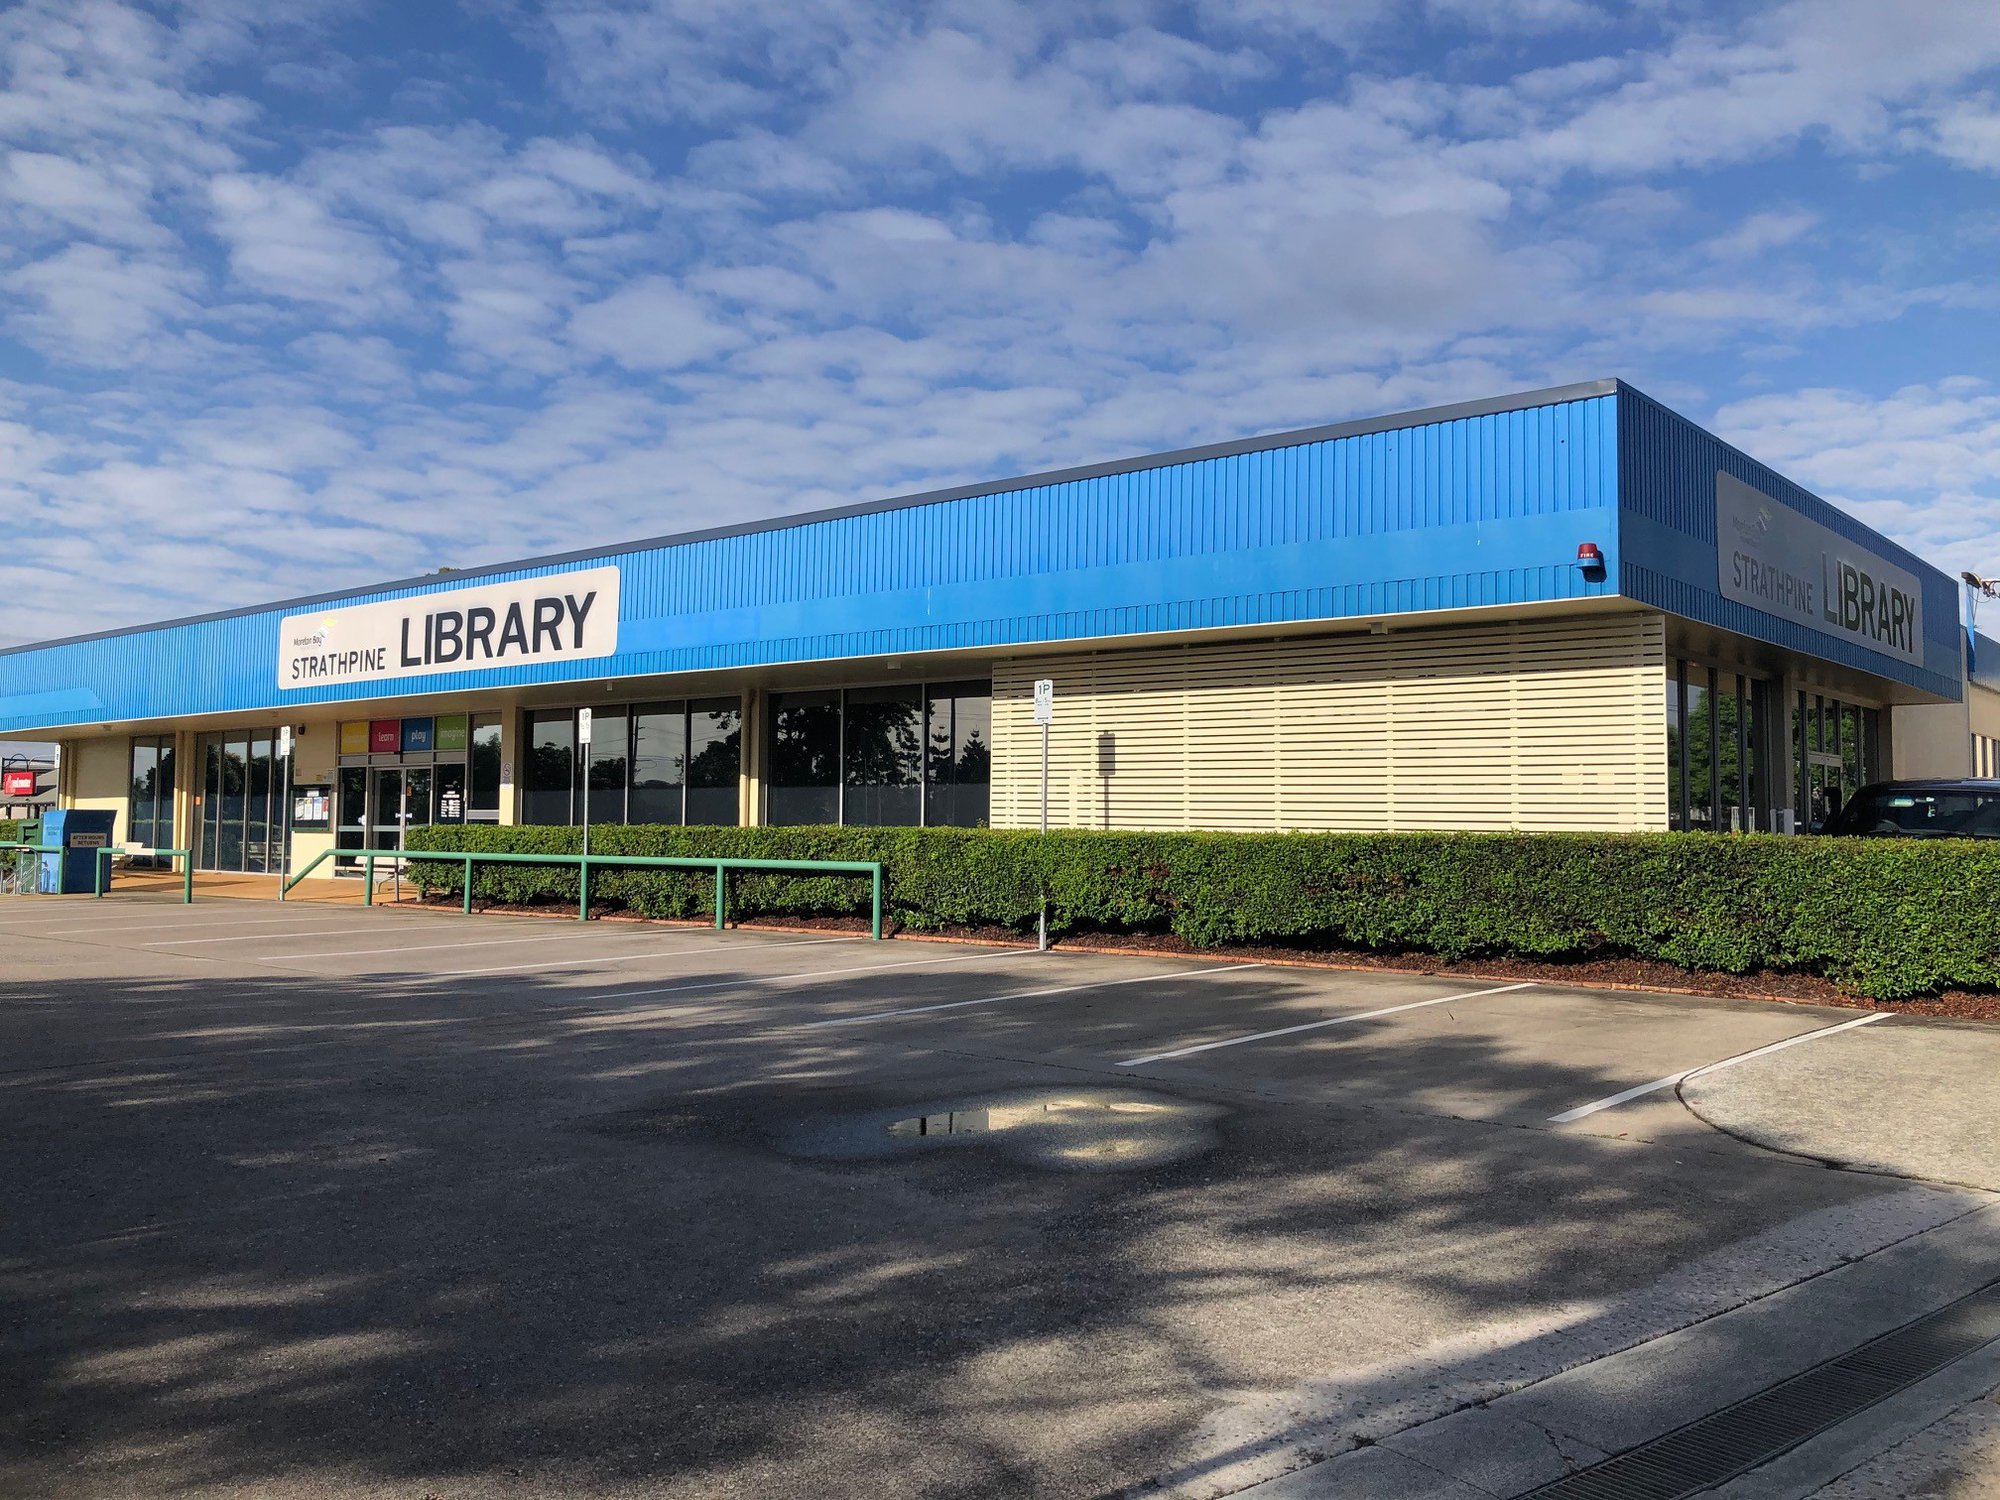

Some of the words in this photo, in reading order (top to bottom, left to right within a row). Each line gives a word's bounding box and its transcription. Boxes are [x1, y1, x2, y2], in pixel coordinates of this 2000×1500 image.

[1732, 551, 1814, 616] STRATHPINE
[1822, 552, 1915, 654] LIBRARY
[292, 648, 386, 680] STRATHPINE
[400, 591, 597, 668] LIBRARY
[312, 635, 322, 647] Bay
[1038, 684, 1051, 695] 1P
[378, 731, 395, 742] learn
[411, 730, 426, 743] play
